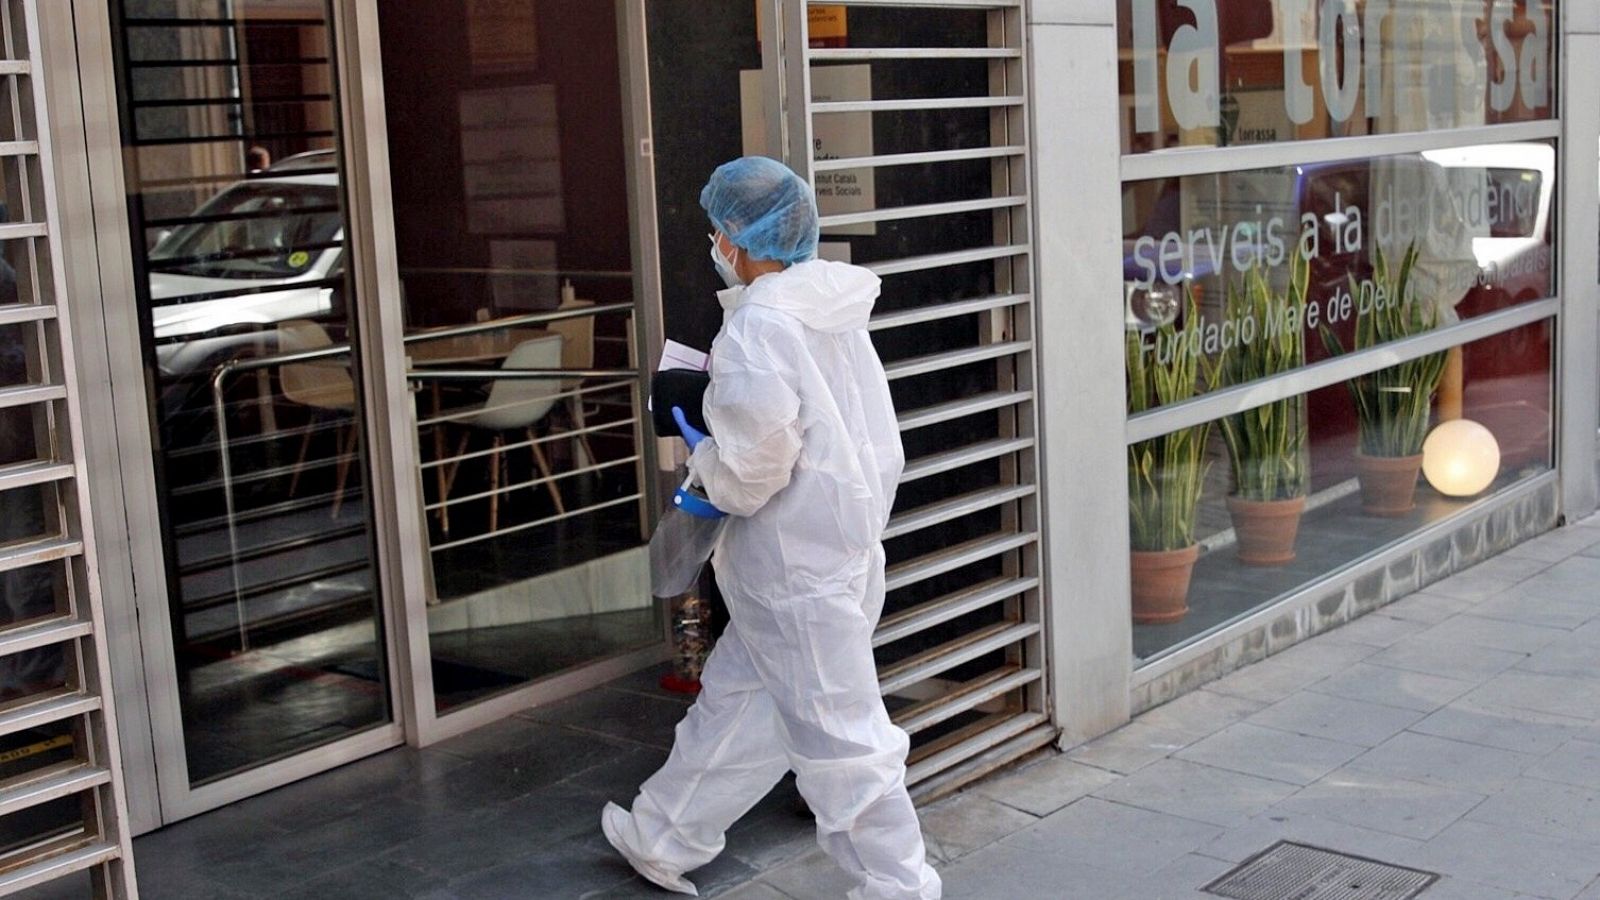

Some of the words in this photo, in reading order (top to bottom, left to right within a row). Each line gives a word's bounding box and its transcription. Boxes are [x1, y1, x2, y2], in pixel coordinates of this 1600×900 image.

[1134, 204, 1284, 291] serveis
[1301, 211, 1319, 261] a
[1334, 191, 1362, 255] la
[1140, 304, 1255, 365] Fundació
[1264, 300, 1319, 341] Mare
[1327, 287, 1351, 325] de
